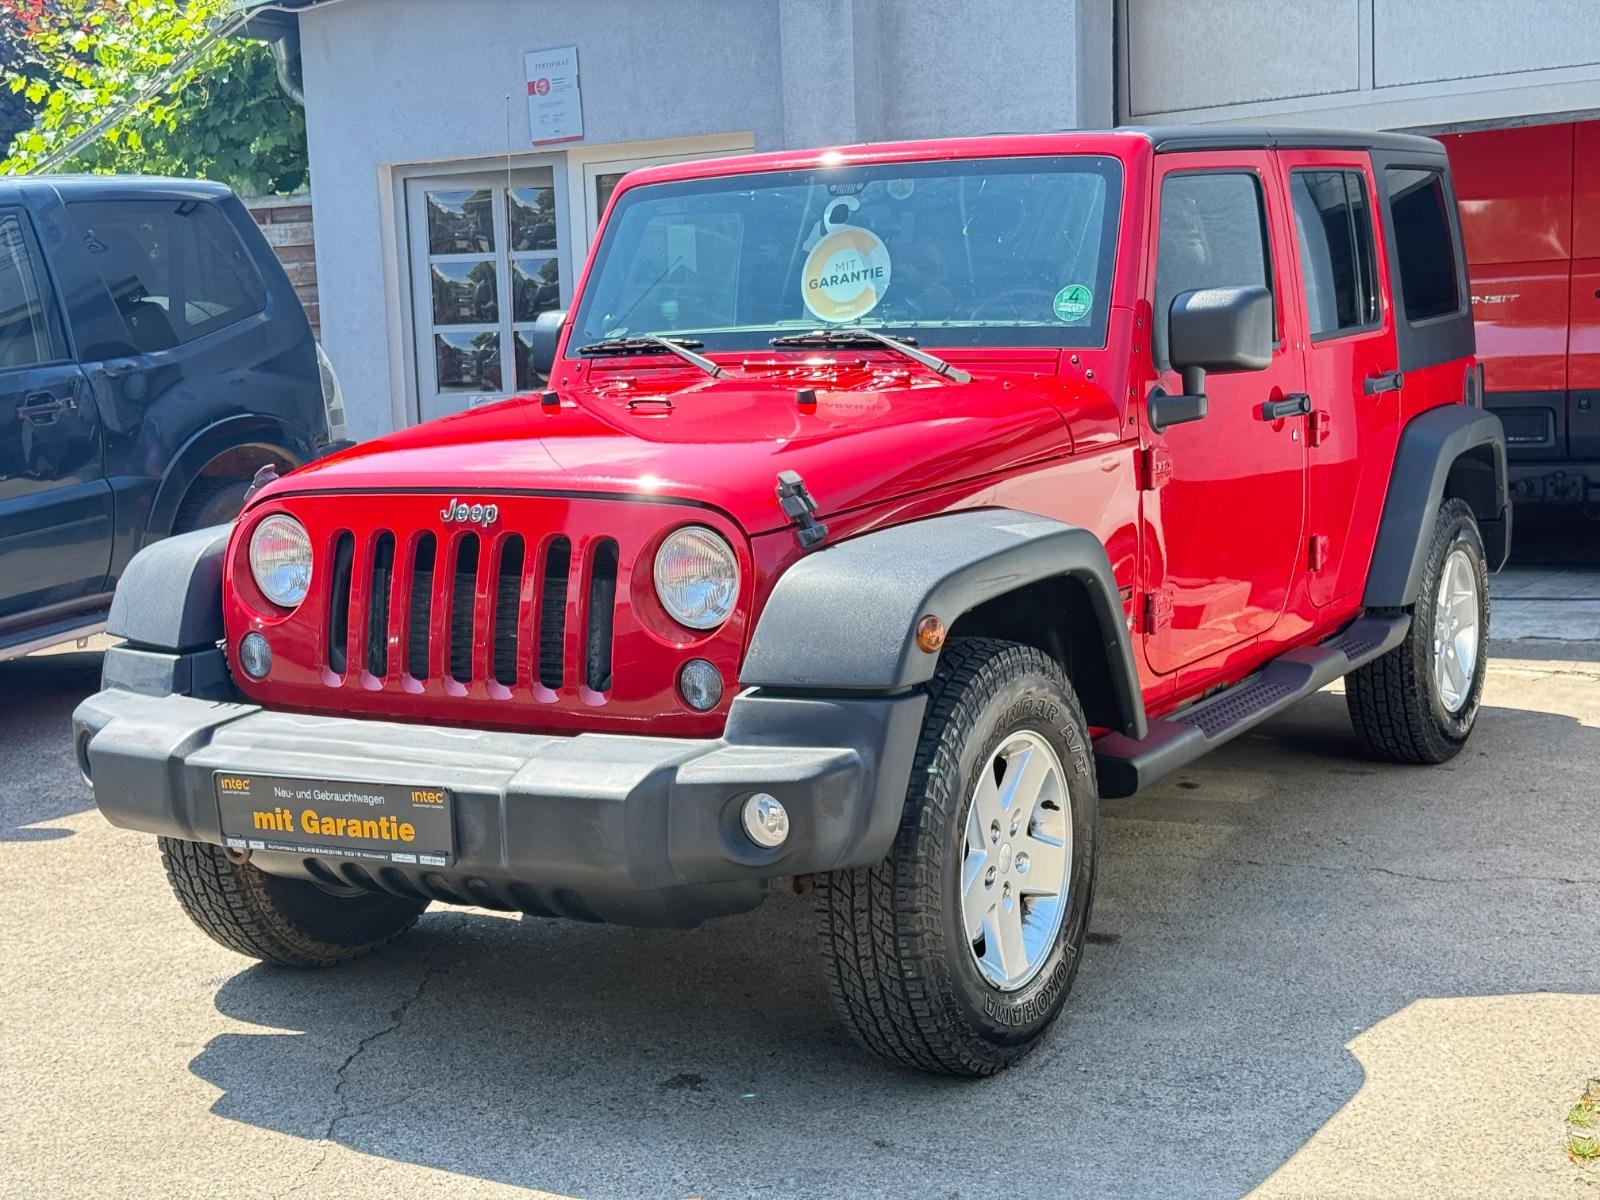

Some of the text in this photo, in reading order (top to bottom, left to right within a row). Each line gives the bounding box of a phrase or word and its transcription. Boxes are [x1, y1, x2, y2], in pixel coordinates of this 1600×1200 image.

[534, 59, 569, 70] ZERTIFIKAT
[834, 259, 857, 272] MIT
[808, 266, 884, 290] GARANTIE
[1064, 287, 1079, 303] 4
[439, 498, 499, 528] Jeep
[1060, 723, 1090, 776] A/T
[221, 778, 250, 790] intec
[274, 786, 385, 807] Neu- und Gebrauchtwagen
[411, 791, 444, 804] intec
[252, 807, 416, 842] mit Garantie
[984, 941, 1077, 1026] YOKOHAMA
